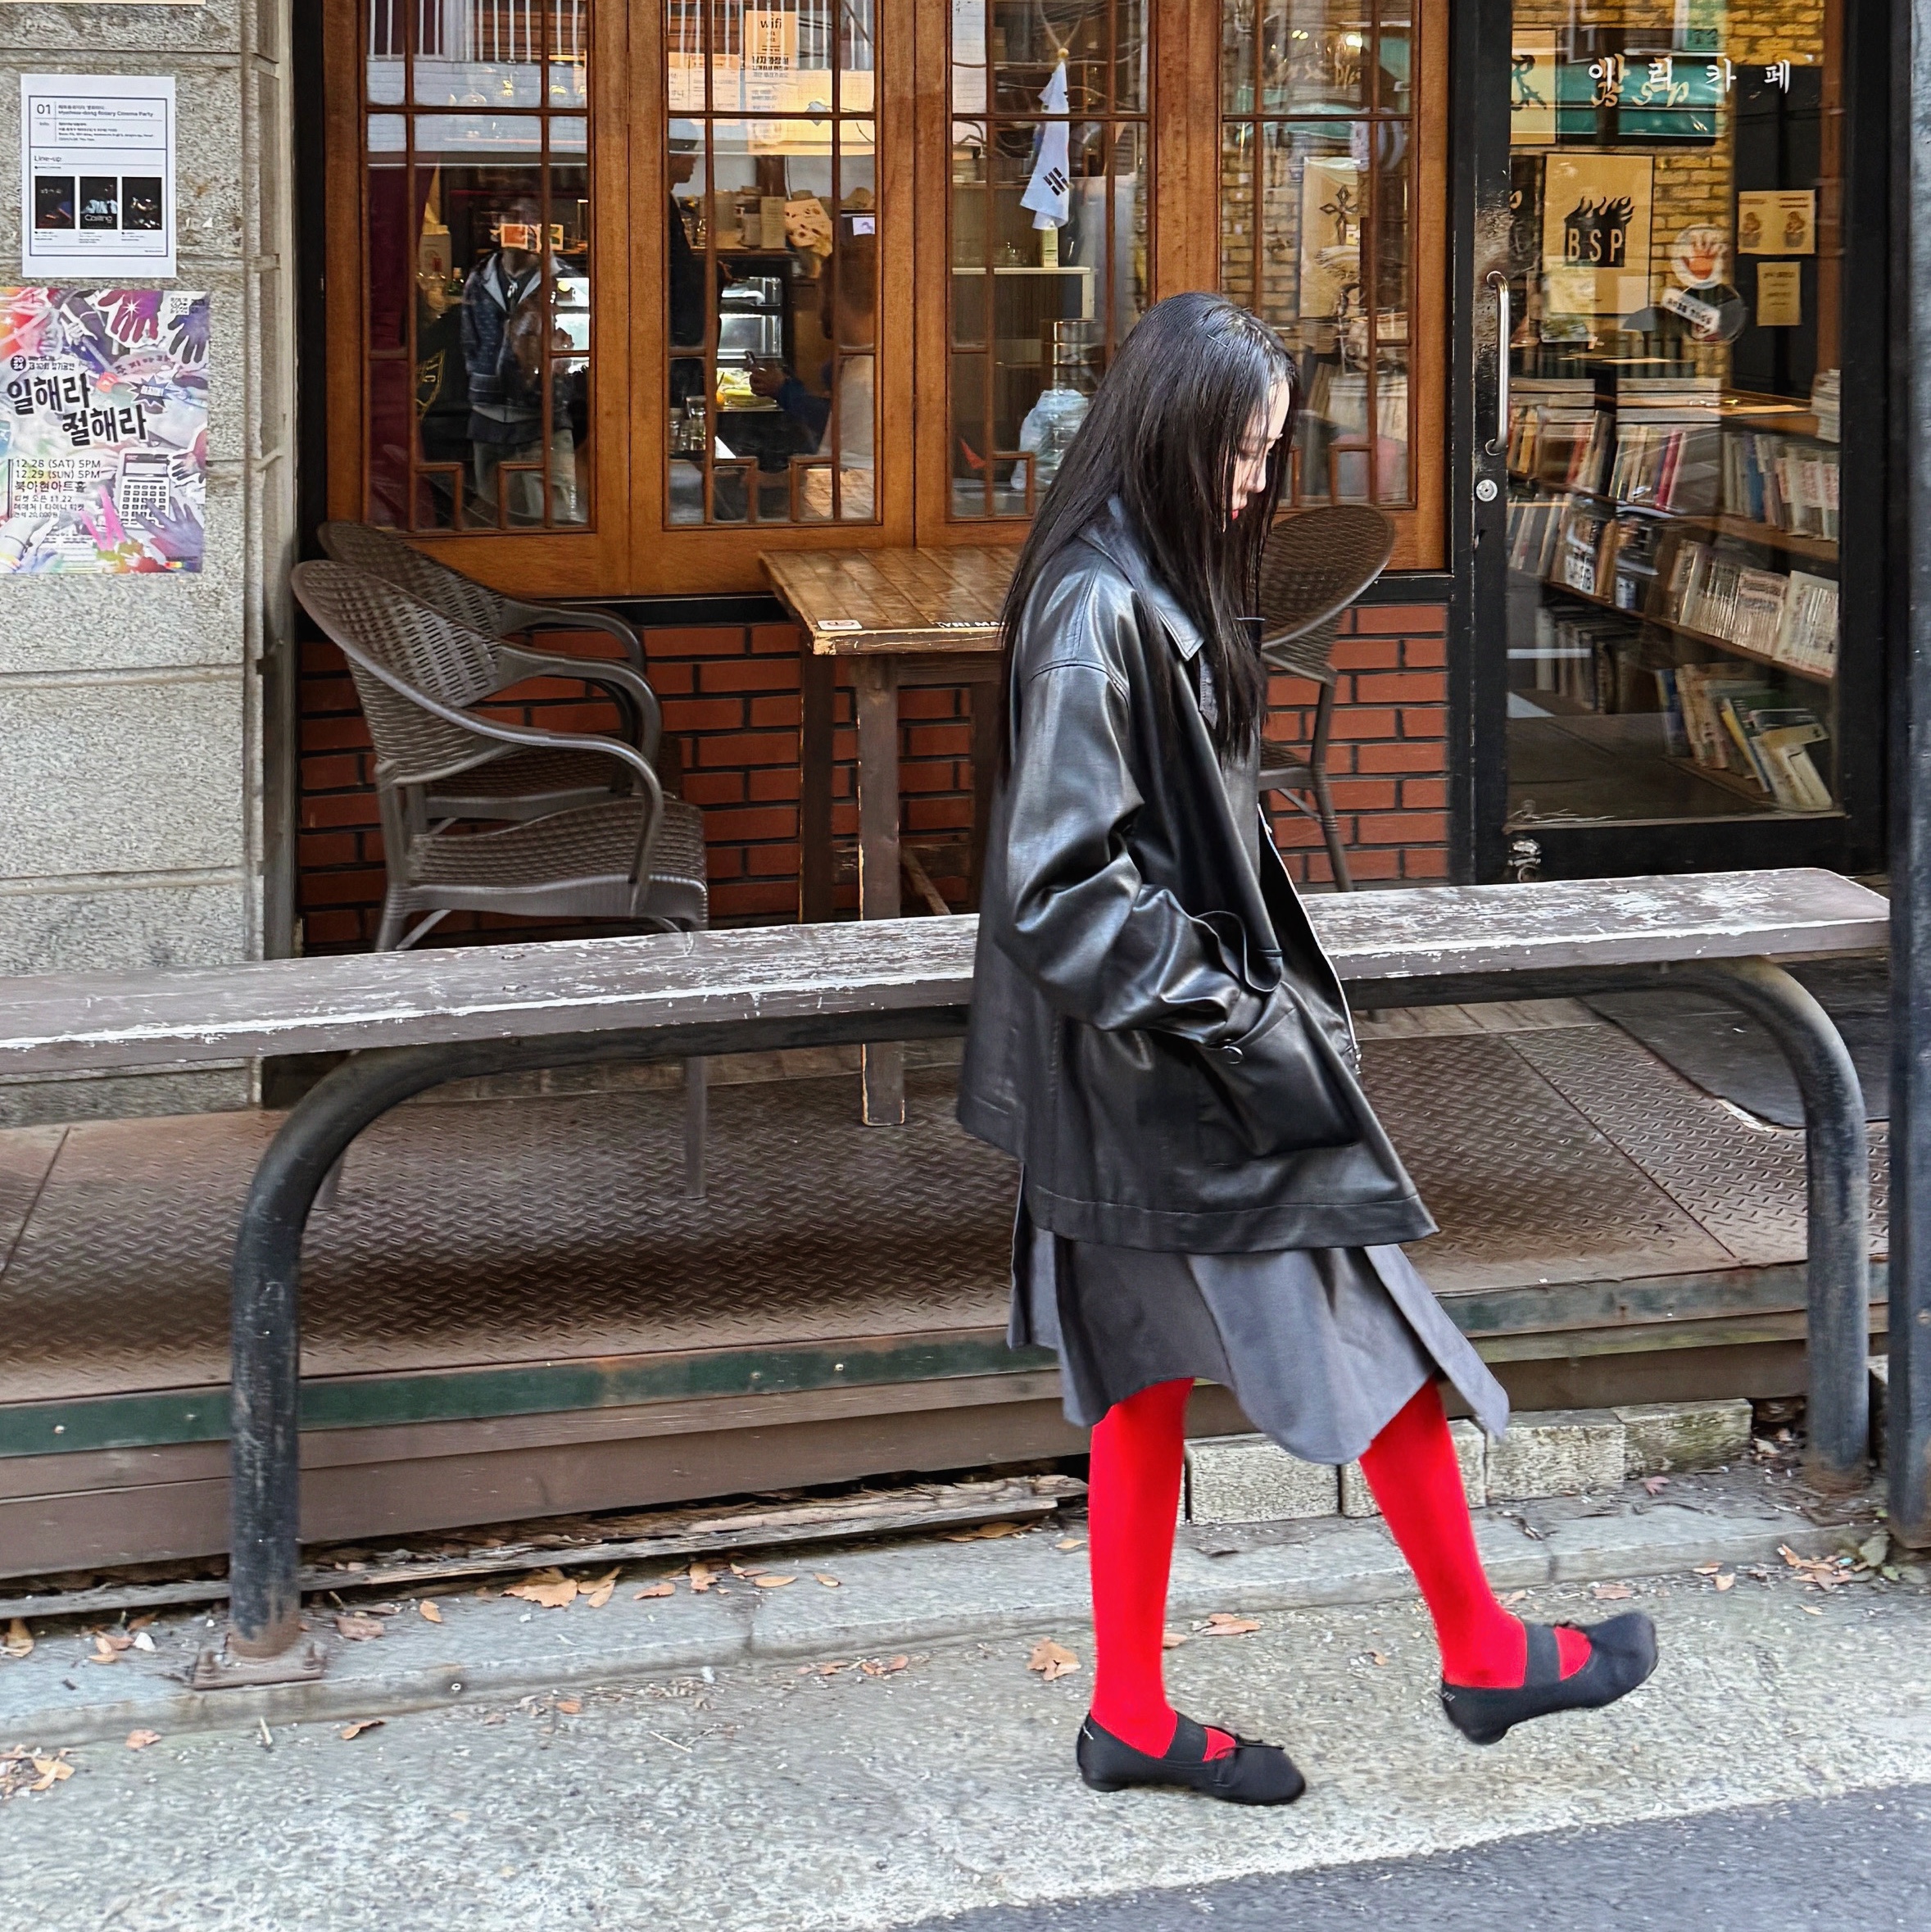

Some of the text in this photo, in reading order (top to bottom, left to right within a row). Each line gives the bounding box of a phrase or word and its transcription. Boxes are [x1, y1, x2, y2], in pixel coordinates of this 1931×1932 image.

[760, 17, 782, 29] wifi
[37, 104, 51, 115] 01
[1567, 228, 1623, 262] BSP
[7, 373, 91, 415] 일해라
[62, 404, 147, 447] 절해라
[48, 460, 75, 468] (SAT)
[16, 470, 100, 478] 12.29 (SUN) 5PM
